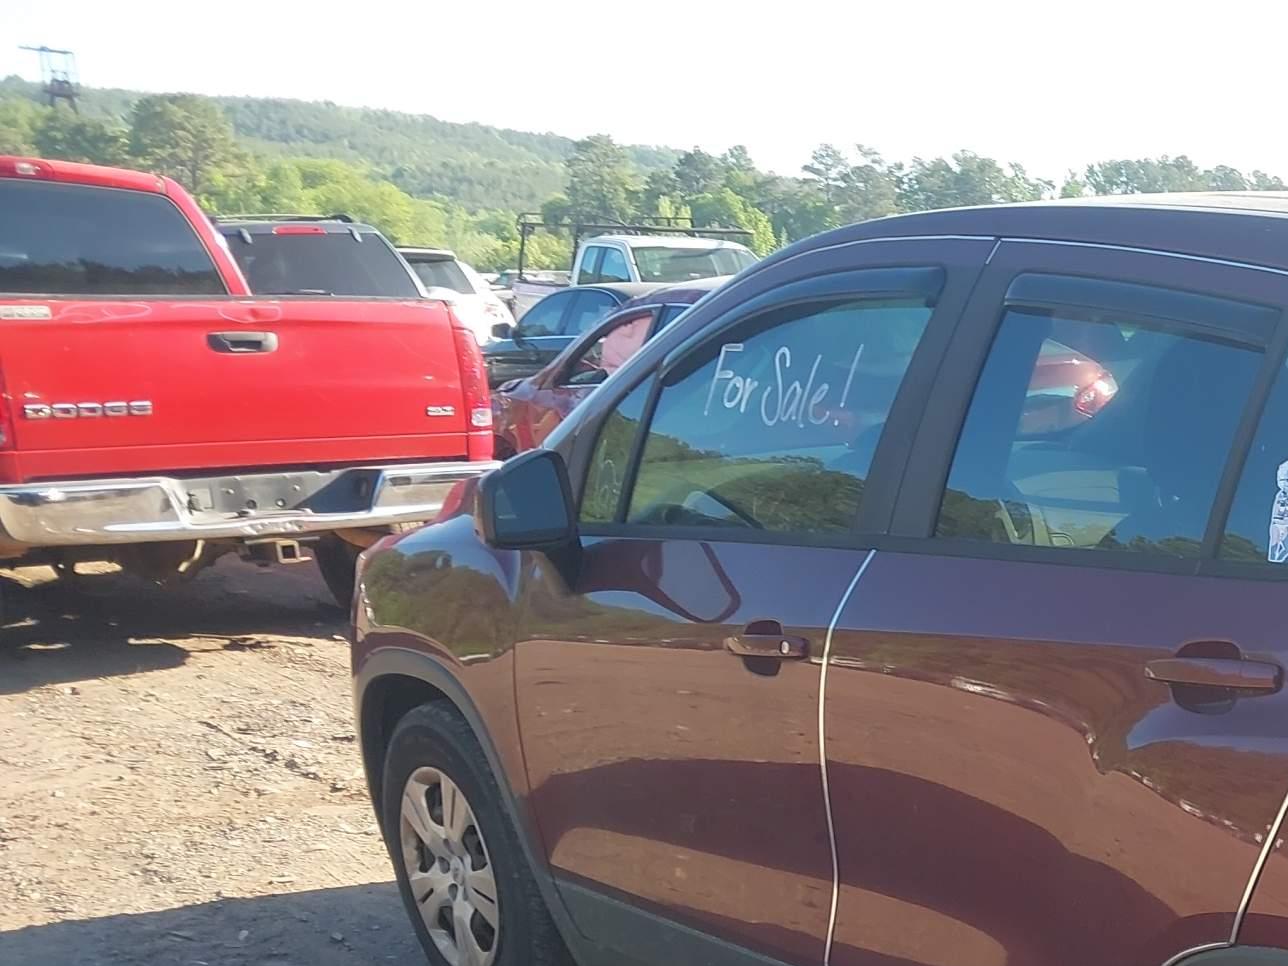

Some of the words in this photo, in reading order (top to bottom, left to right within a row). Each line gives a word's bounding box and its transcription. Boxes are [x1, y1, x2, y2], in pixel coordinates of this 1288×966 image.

[24, 401, 152, 418] DODGE
[704, 343, 758, 416] For
[761, 345, 864, 428] Sale!
